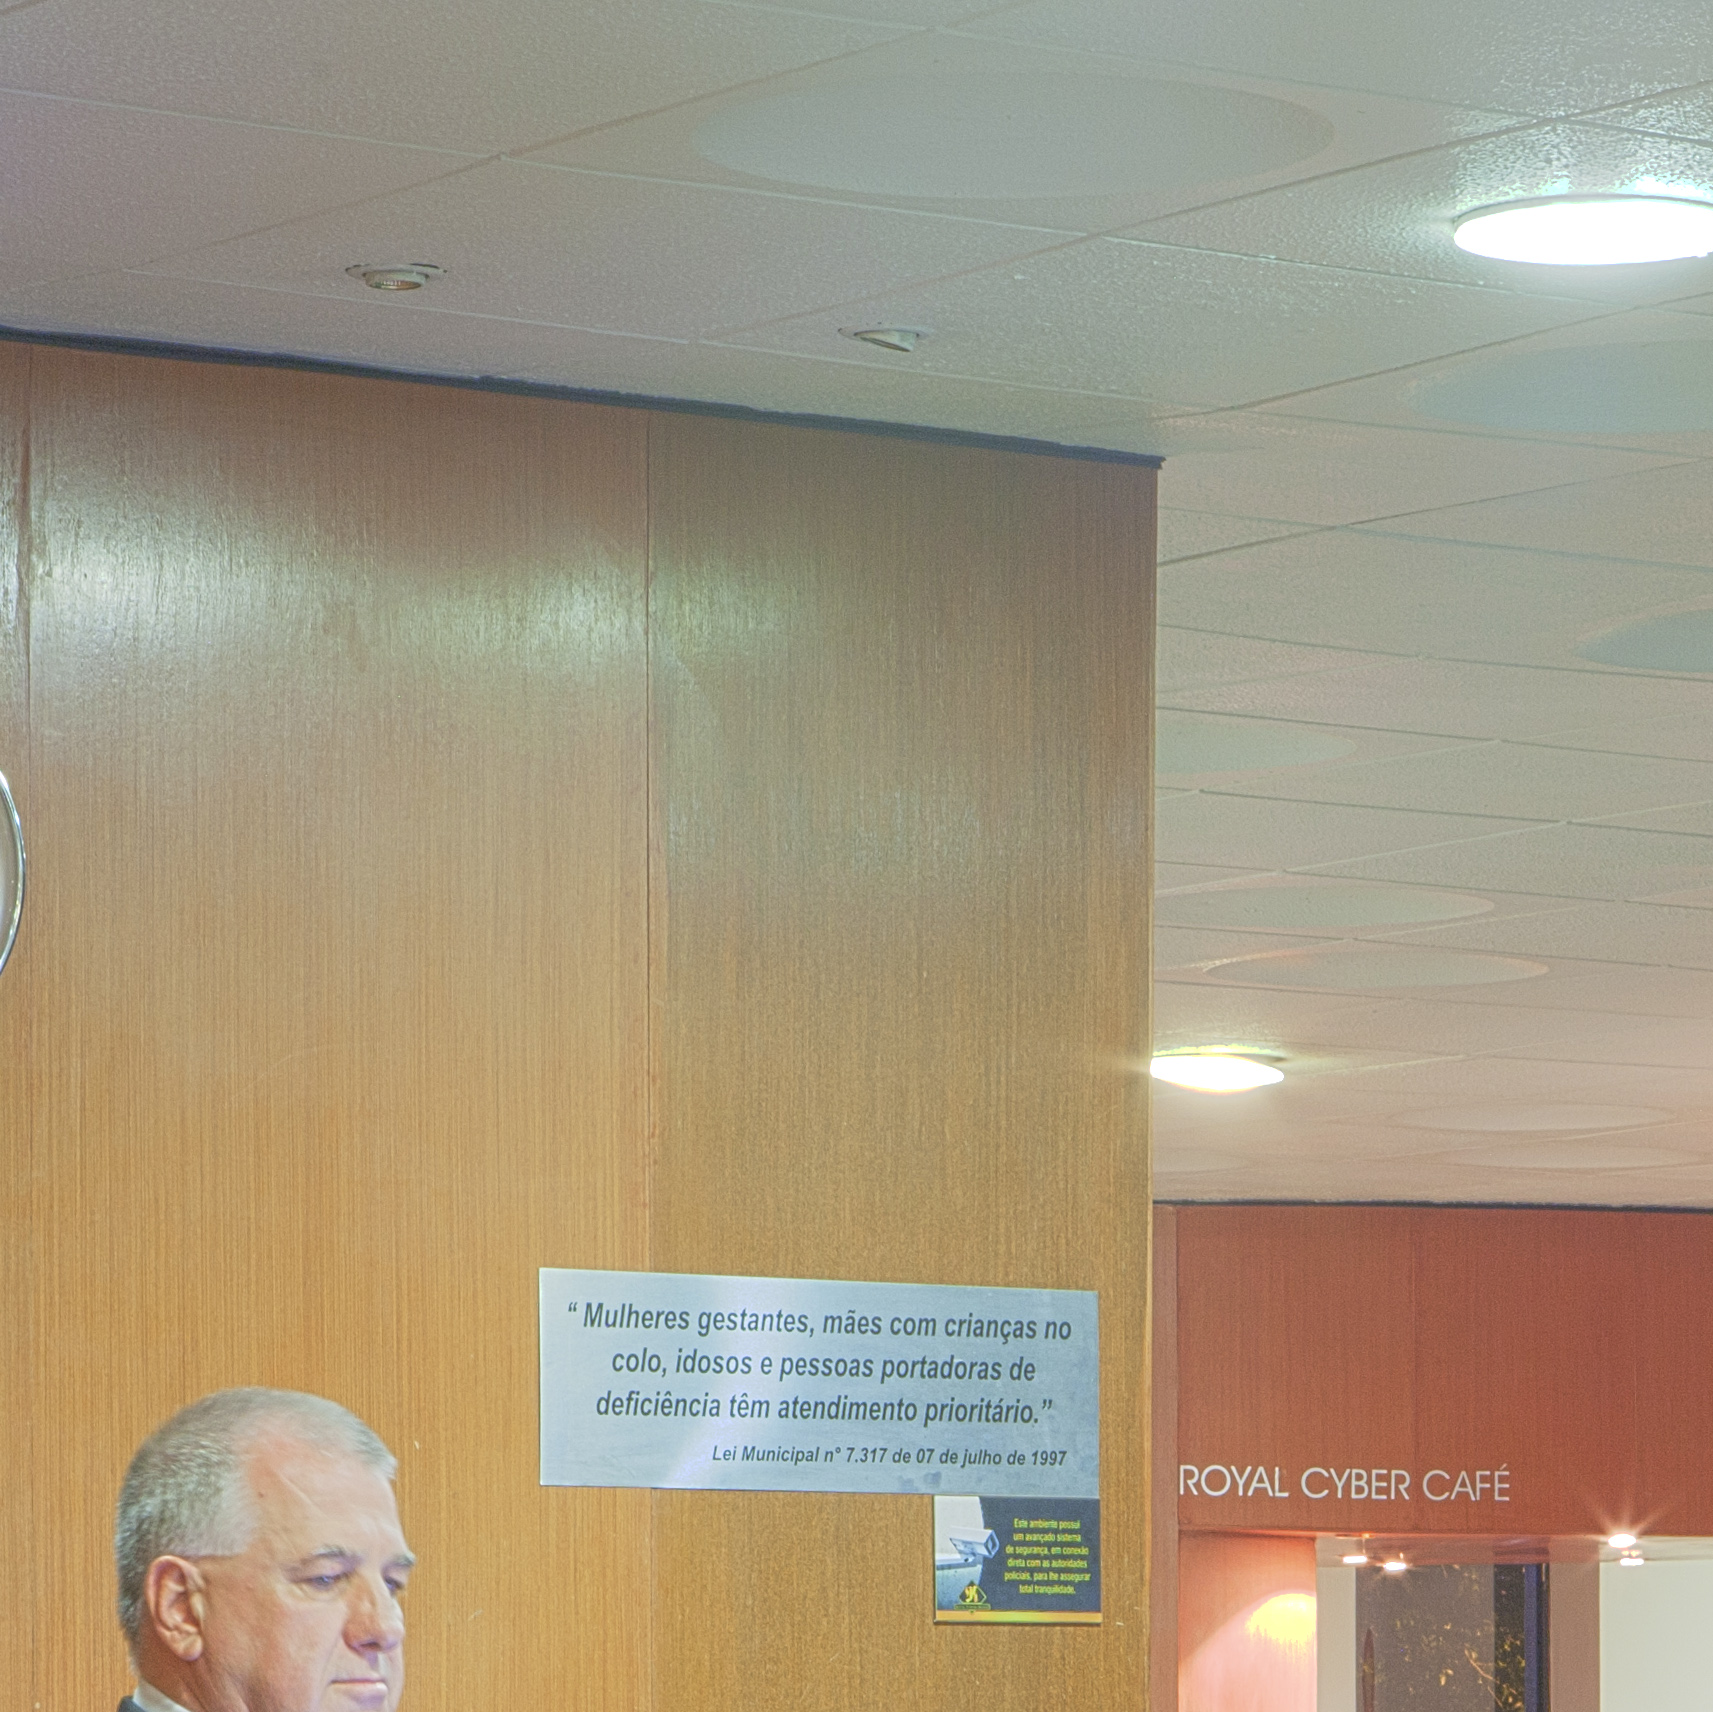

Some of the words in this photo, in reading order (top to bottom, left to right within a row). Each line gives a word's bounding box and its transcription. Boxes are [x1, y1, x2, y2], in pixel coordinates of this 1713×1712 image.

[583, 1302, 690, 1330] Mulheres
[697, 1307, 815, 1338] gestantes,
[822, 1309, 883, 1335] mães
[890, 1315, 937, 1337] com
[944, 1312, 1038, 1345] crianças
[1043, 1319, 1072, 1341] no
[611, 1347, 668, 1378] colo,
[675, 1348, 753, 1375] idosos
[760, 1355, 773, 1376] e
[779, 1355, 874, 1383] pessoas
[880, 1354, 1003, 1385] portadoras
[1009, 1356, 1036, 1382] de
[596, 1390, 721, 1418] deficiência
[729, 1392, 771, 1419] têm
[777, 1395, 918, 1422] atendimento
[712, 1445, 737, 1462] Lei
[741, 1445, 820, 1466] Municipal
[846, 1447, 888, 1464] 7.317
[892, 1448, 912, 1464] de
[916, 1448, 935, 1465] 07
[939, 1449, 959, 1465] de
[960, 1449, 1002, 1469] julho
[1006, 1450, 1026, 1466] de
[1031, 1450, 1068, 1467] 1997
[1179, 1464, 1289, 1497] ROYAL
[1300, 1467, 1410, 1500] CYBER
[1422, 1462, 1510, 1502] CAFÉ
[1013, 1533, 1024, 1541] um
[1026, 1559, 1041, 1567] com
[1033, 1572, 1048, 1582] para
